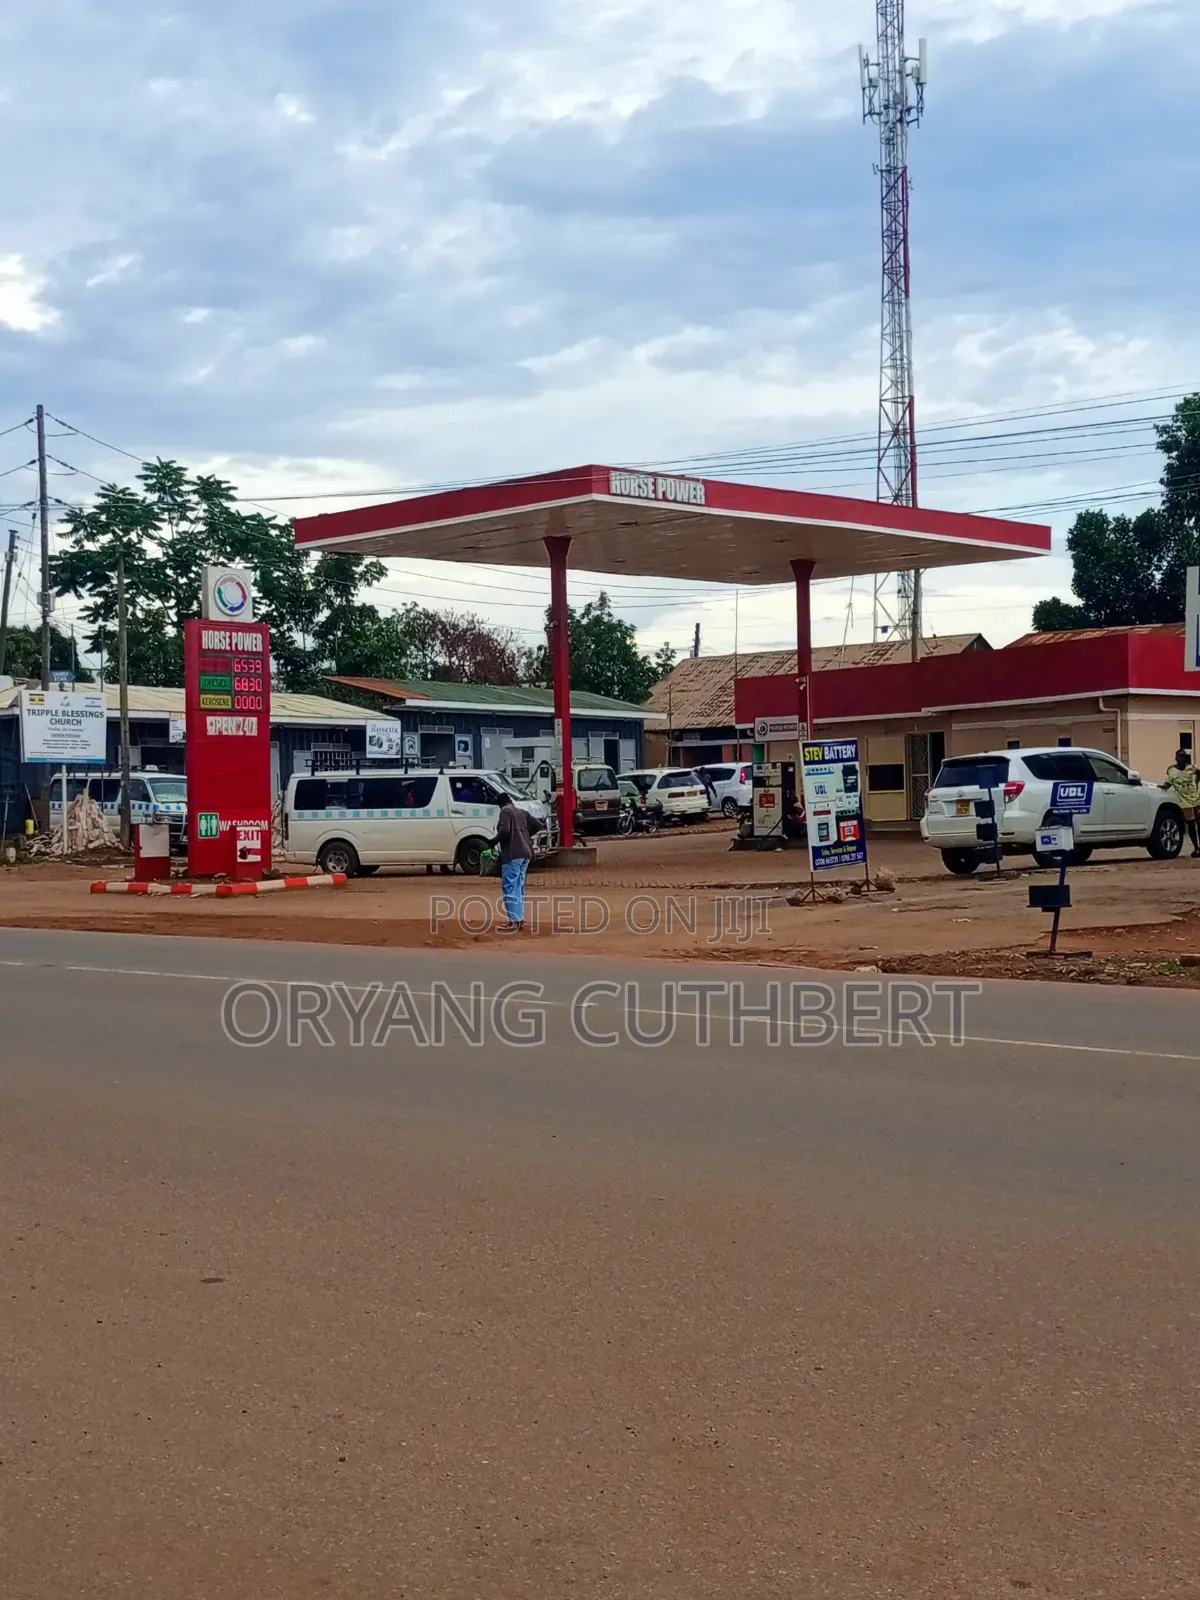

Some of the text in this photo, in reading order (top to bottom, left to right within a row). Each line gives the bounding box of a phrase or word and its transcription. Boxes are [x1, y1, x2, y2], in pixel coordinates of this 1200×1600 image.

[609, 470, 705, 505] HORSE POWER
[202, 630, 263, 653] HORSE POWER
[234, 658, 262, 674] 6539
[234, 677, 263, 692] 6830
[202, 695, 263, 710] KEROSENE 0000
[26, 708, 105, 719] TRIPPLE BLESSINGS
[49, 717, 83, 727] CHURCH
[206, 716, 236, 736] OPEN
[804, 744, 857, 761] STEV BATTERY
[238, 829, 261, 841] EXIT
